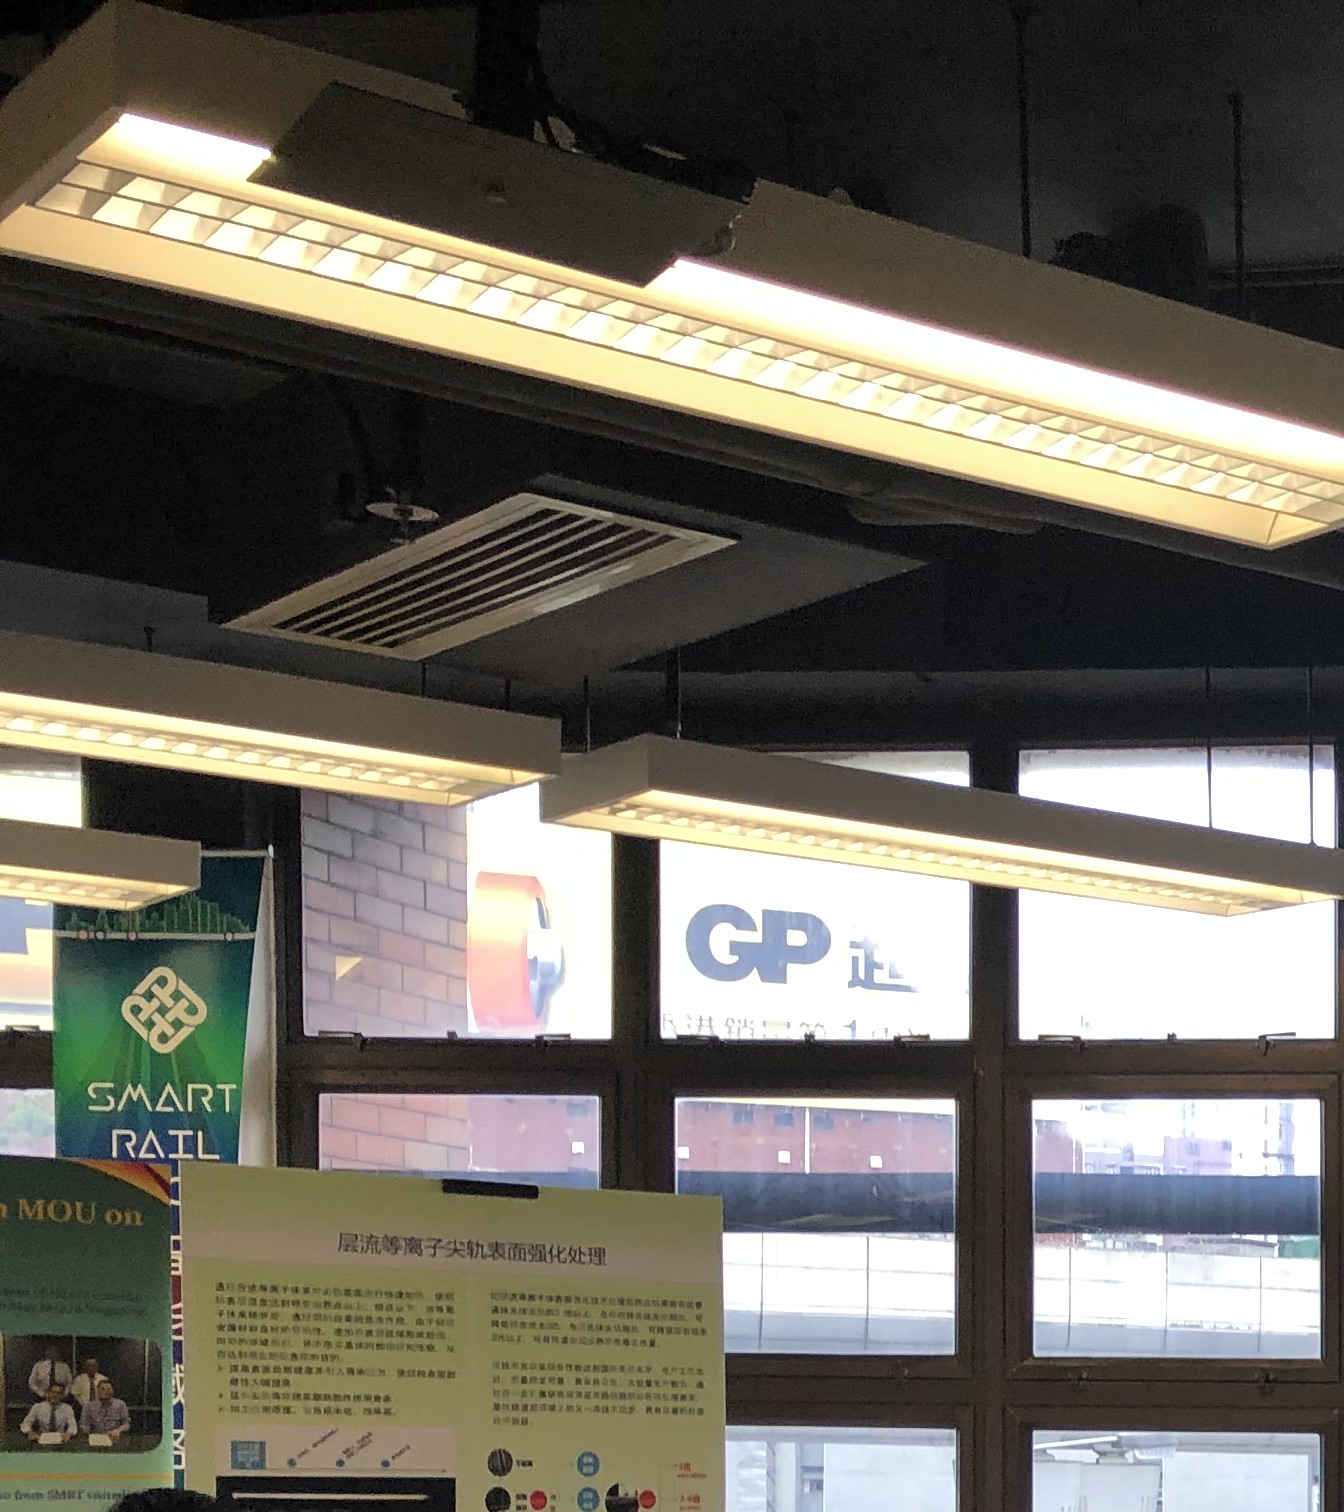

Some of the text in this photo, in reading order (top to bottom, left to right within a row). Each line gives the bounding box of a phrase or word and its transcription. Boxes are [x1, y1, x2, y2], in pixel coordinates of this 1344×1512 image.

[686, 904, 831, 984] GP
[87, 1082, 237, 1113] SMART
[111, 1129, 220, 1160] RAIL
[18, 1199, 96, 1225] MOU
[104, 1207, 143, 1226] on
